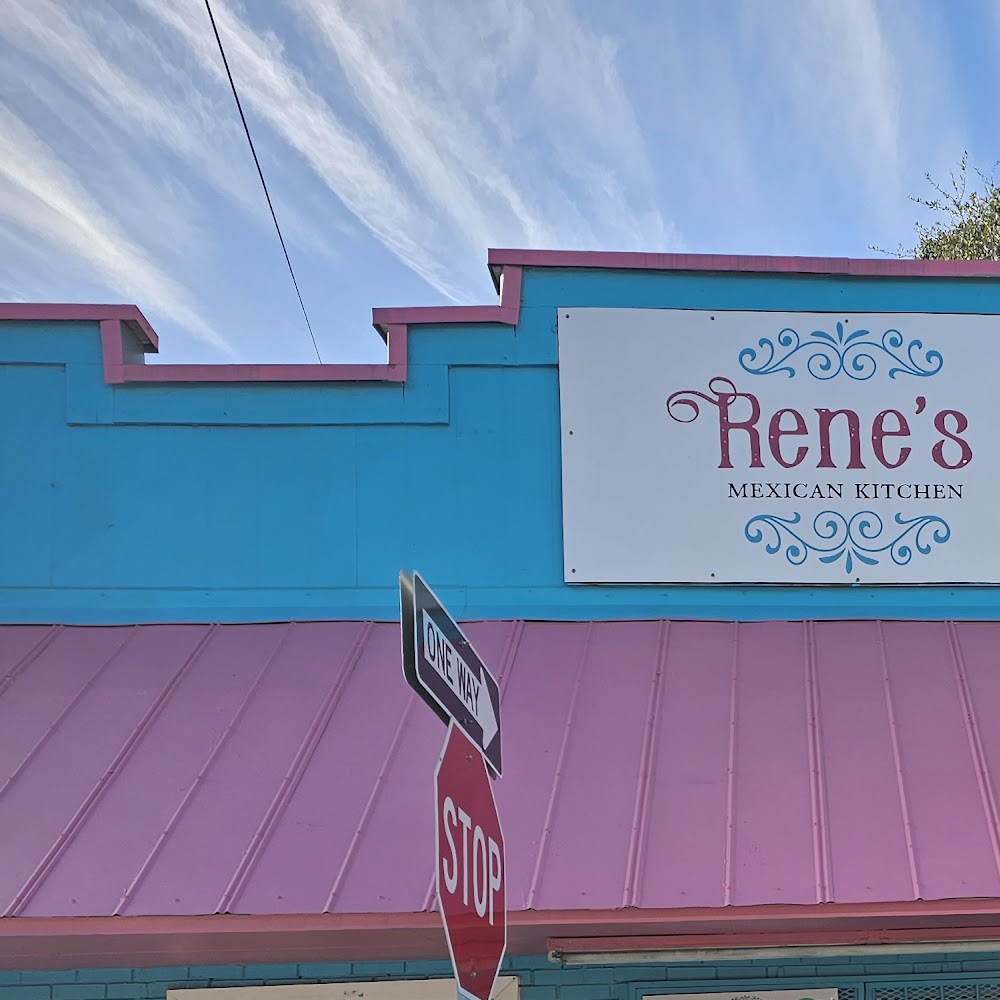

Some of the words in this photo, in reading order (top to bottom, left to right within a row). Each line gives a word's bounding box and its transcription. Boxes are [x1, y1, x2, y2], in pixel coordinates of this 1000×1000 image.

[666, 376, 973, 469] Rene's
[728, 483, 843, 499] MEXICAN
[855, 483, 964, 500] KITCHEN
[428, 622, 454, 685] ONE
[457, 657, 479, 716] WAY
[443, 796, 501, 925] STOP
